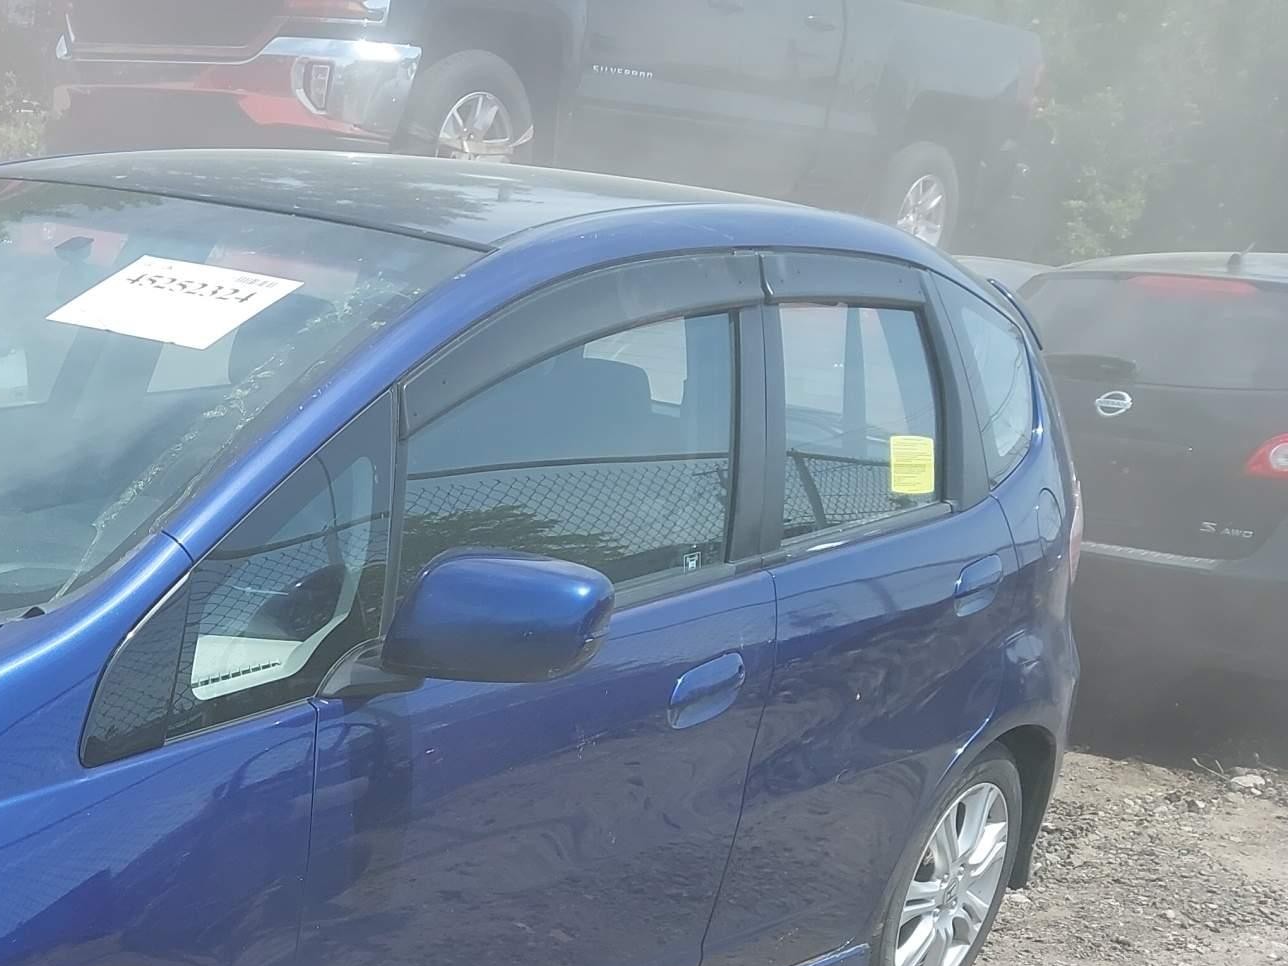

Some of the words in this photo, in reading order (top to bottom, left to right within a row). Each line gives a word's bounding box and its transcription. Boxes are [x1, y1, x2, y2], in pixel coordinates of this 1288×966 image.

[125, 273, 257, 304] 45252324
[1199, 521, 1217, 534] S
[1221, 528, 1254, 538] AWD
